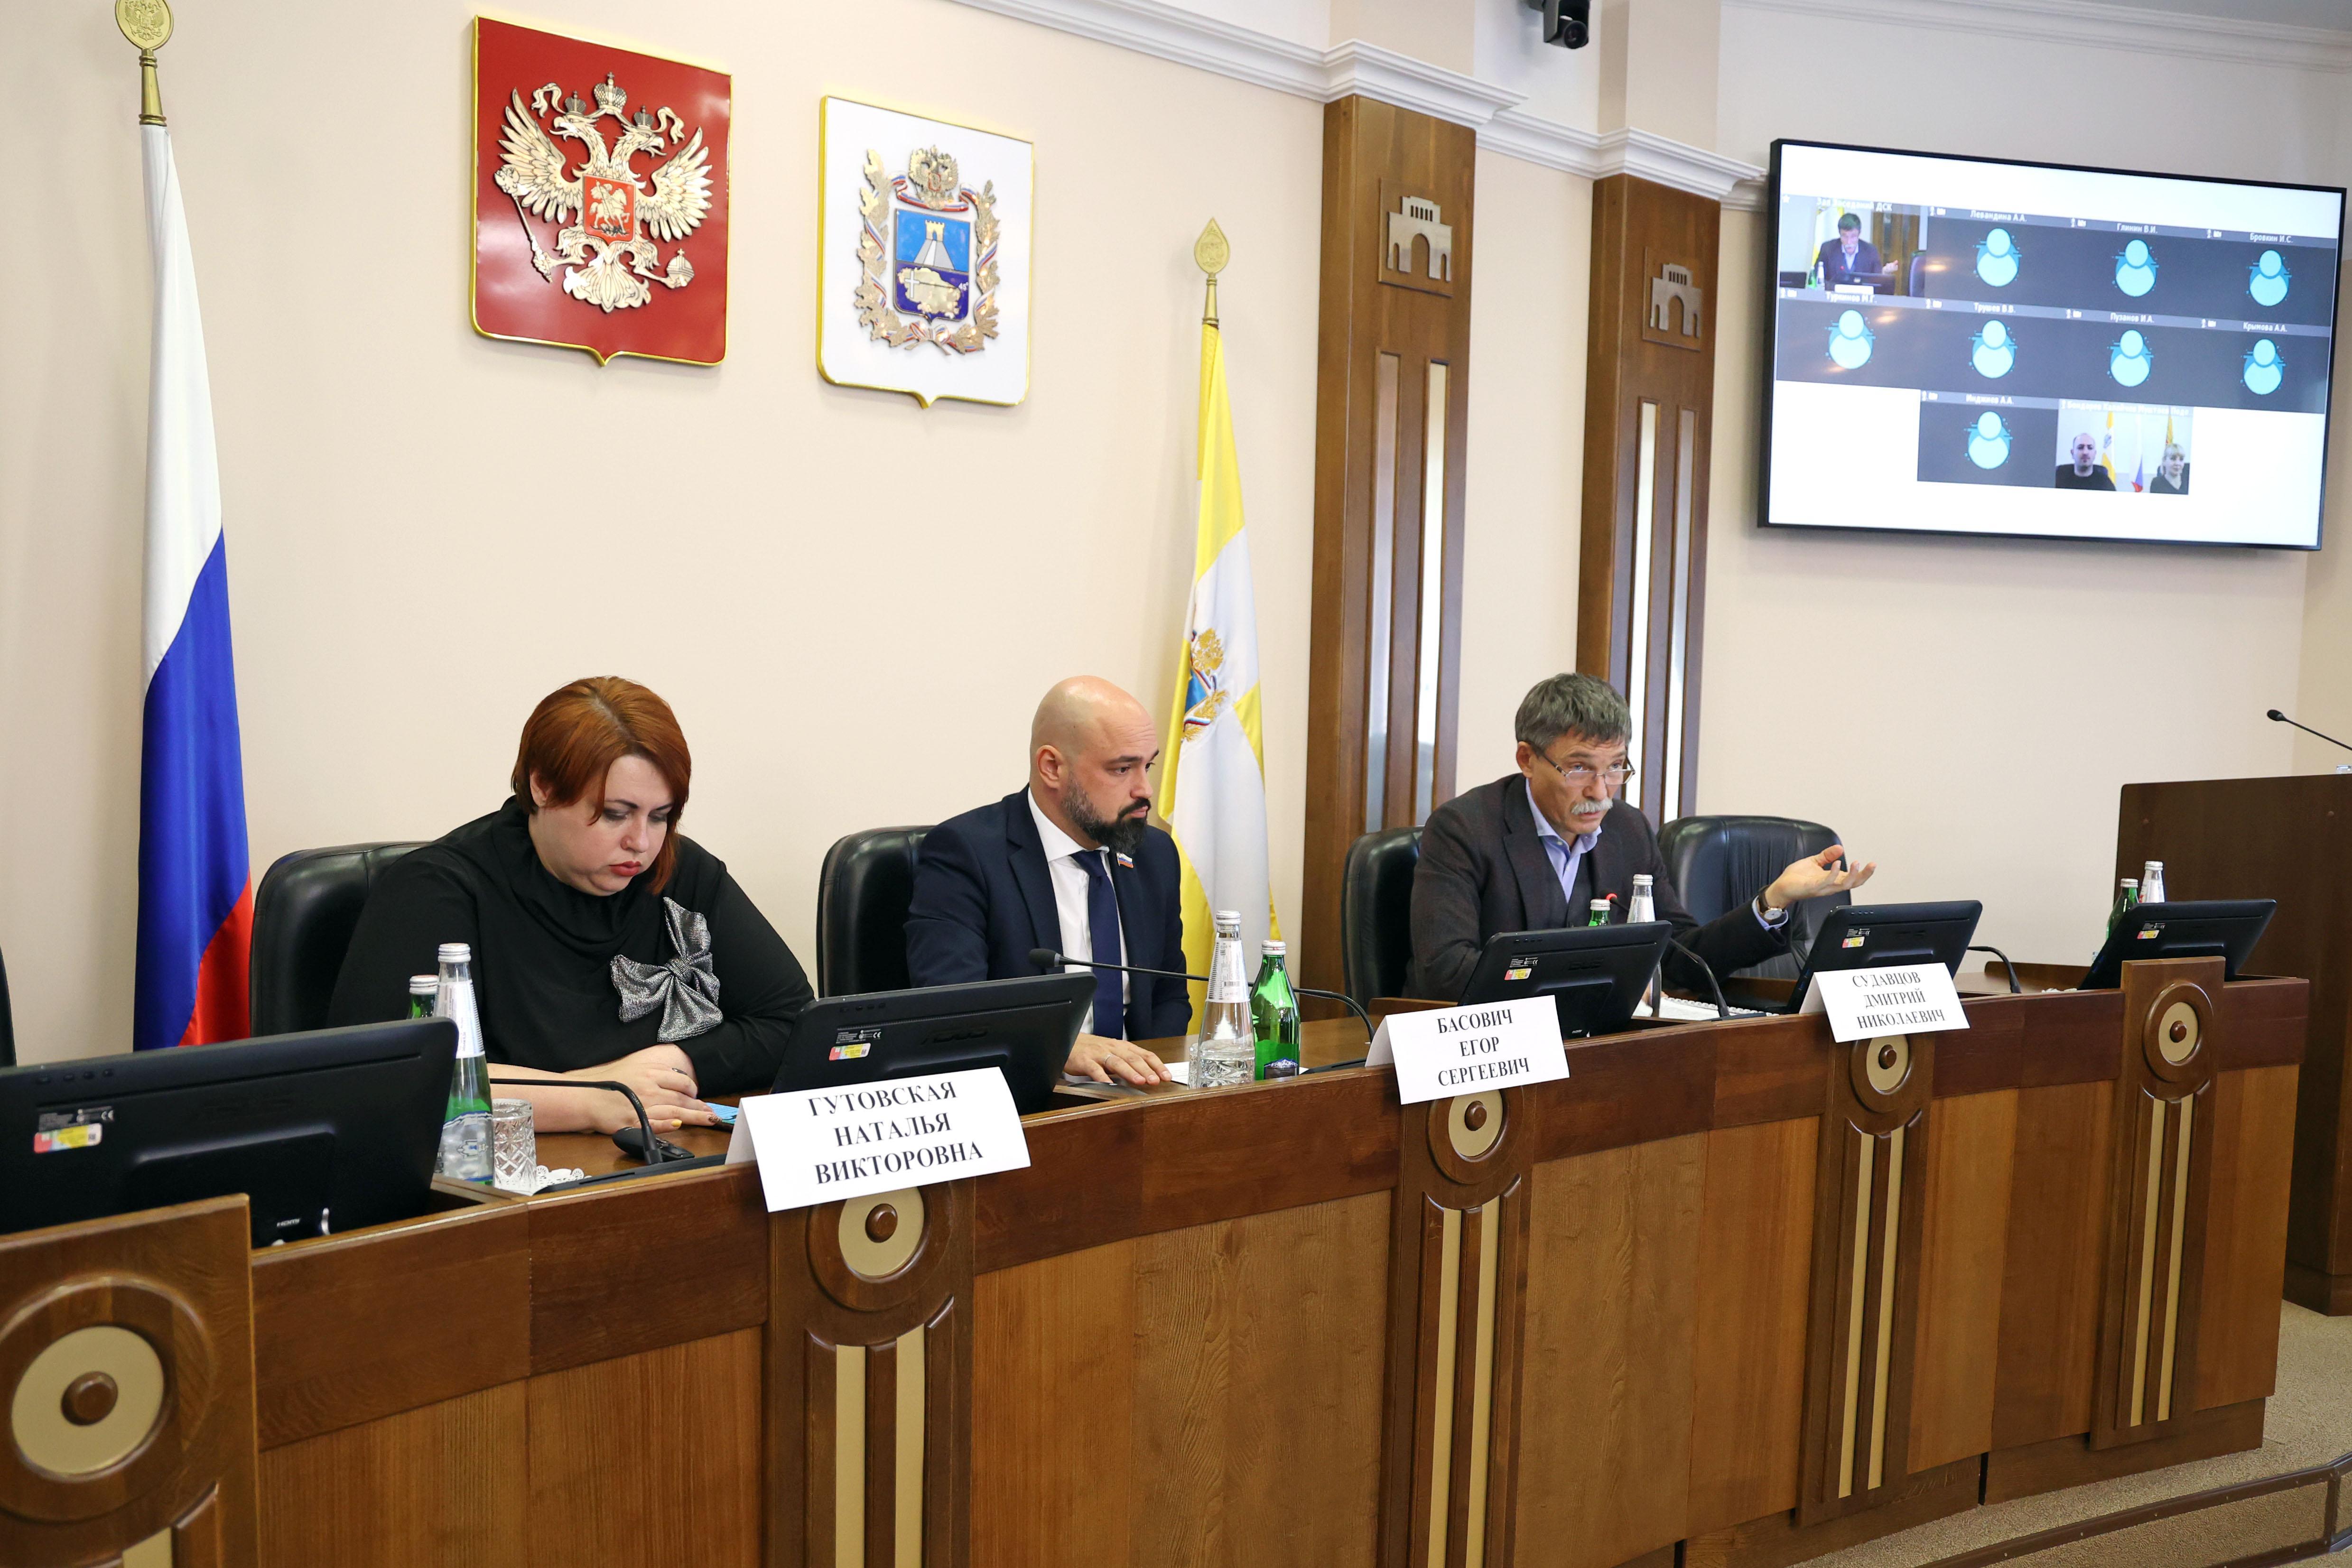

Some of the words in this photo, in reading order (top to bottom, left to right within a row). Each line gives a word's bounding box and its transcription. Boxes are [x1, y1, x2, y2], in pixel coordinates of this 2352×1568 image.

[1876, 202, 1893, 212] ДСК
[2117, 223, 2142, 232] Глинин
[2144, 225, 2158, 234] В.И.
[2250, 232, 2278, 242] Бровкин
[2279, 235, 2293, 243] И.С.
[2110, 312, 2139, 323] Пузанов
[2140, 315, 2155, 323] И.А.
[2243, 322, 2273, 332] Крымова
[2274, 324, 2287, 332] А.А.
[1852, 972, 1921, 987] СУДАВЦОВ
[1863, 988, 1926, 1009] ДМИТРИЙ
[1437, 1009, 1514, 1034] БАСОВИЧ
[1857, 1009, 1946, 1029] НИКОЛАЕВИЧ
[1459, 1036, 1499, 1057] ЕГОР
[1438, 1058, 1531, 1086] СЕРГЕЕВИЧ
[807, 1082, 958, 1117] ГУТОВСКАЯ
[833, 1113, 953, 1147] НАТАЛЬЯ
[814, 1141, 984, 1185] ВИКТОРОВНА
